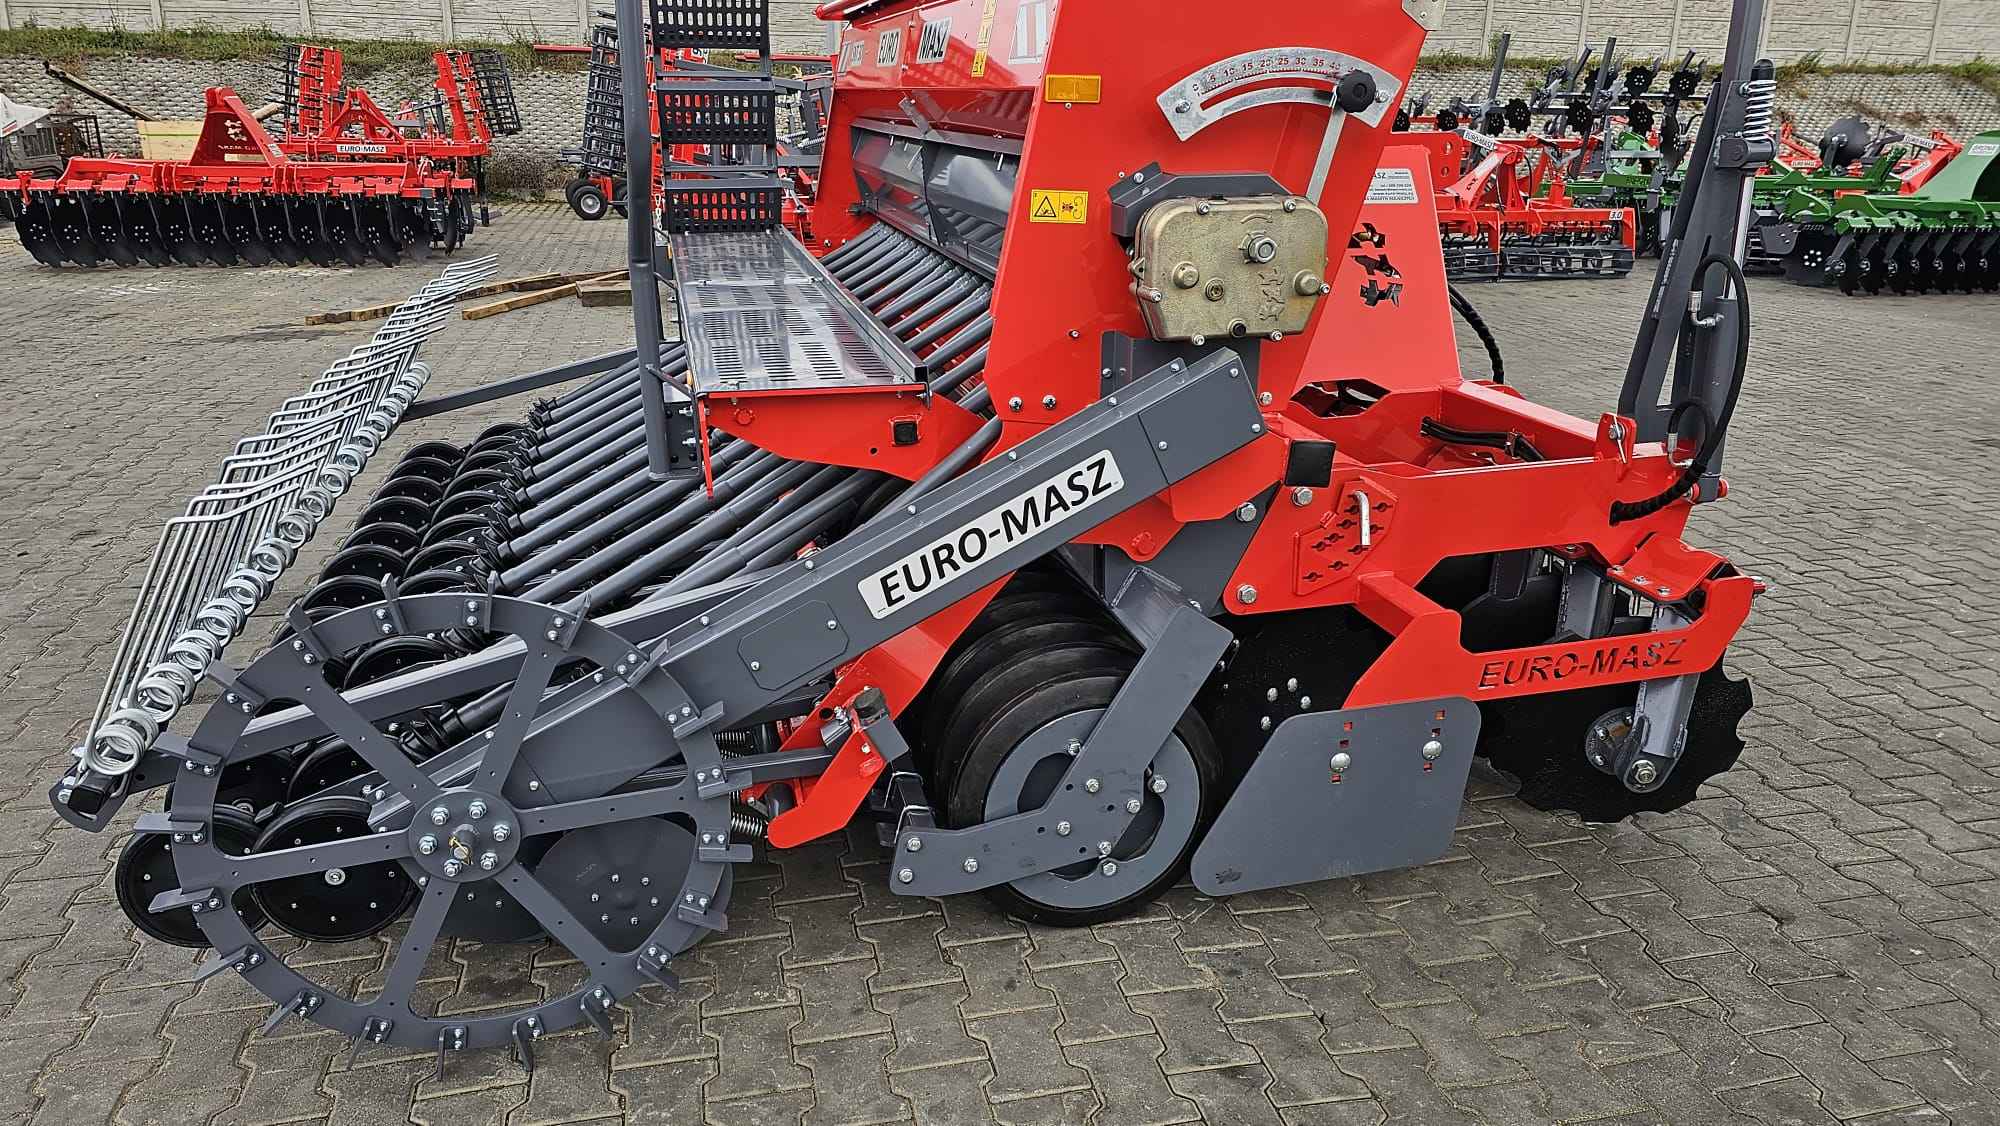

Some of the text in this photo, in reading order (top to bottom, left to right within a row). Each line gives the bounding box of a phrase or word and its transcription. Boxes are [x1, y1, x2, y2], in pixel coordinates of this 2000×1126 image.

[878, 31, 899, 64] EURO
[919, 22, 949, 59] MASZ
[1209, 74, 1217, 83] 5
[1223, 67, 1236, 77] 10
[1242, 62, 1254, 71] 15
[1258, 59, 1272, 68] 20
[1277, 57, 1290, 66] 25
[1295, 57, 1307, 66] 30
[1313, 58, 1325, 67] 35
[1329, 61, 1342, 71] 40
[339, 145, 385, 153] EURO-MASZ
[1611, 210, 1623, 219] 3.0
[879, 457, 1113, 608] EURO-MASZ
[1477, 638, 1688, 691] EURO-MASZ
